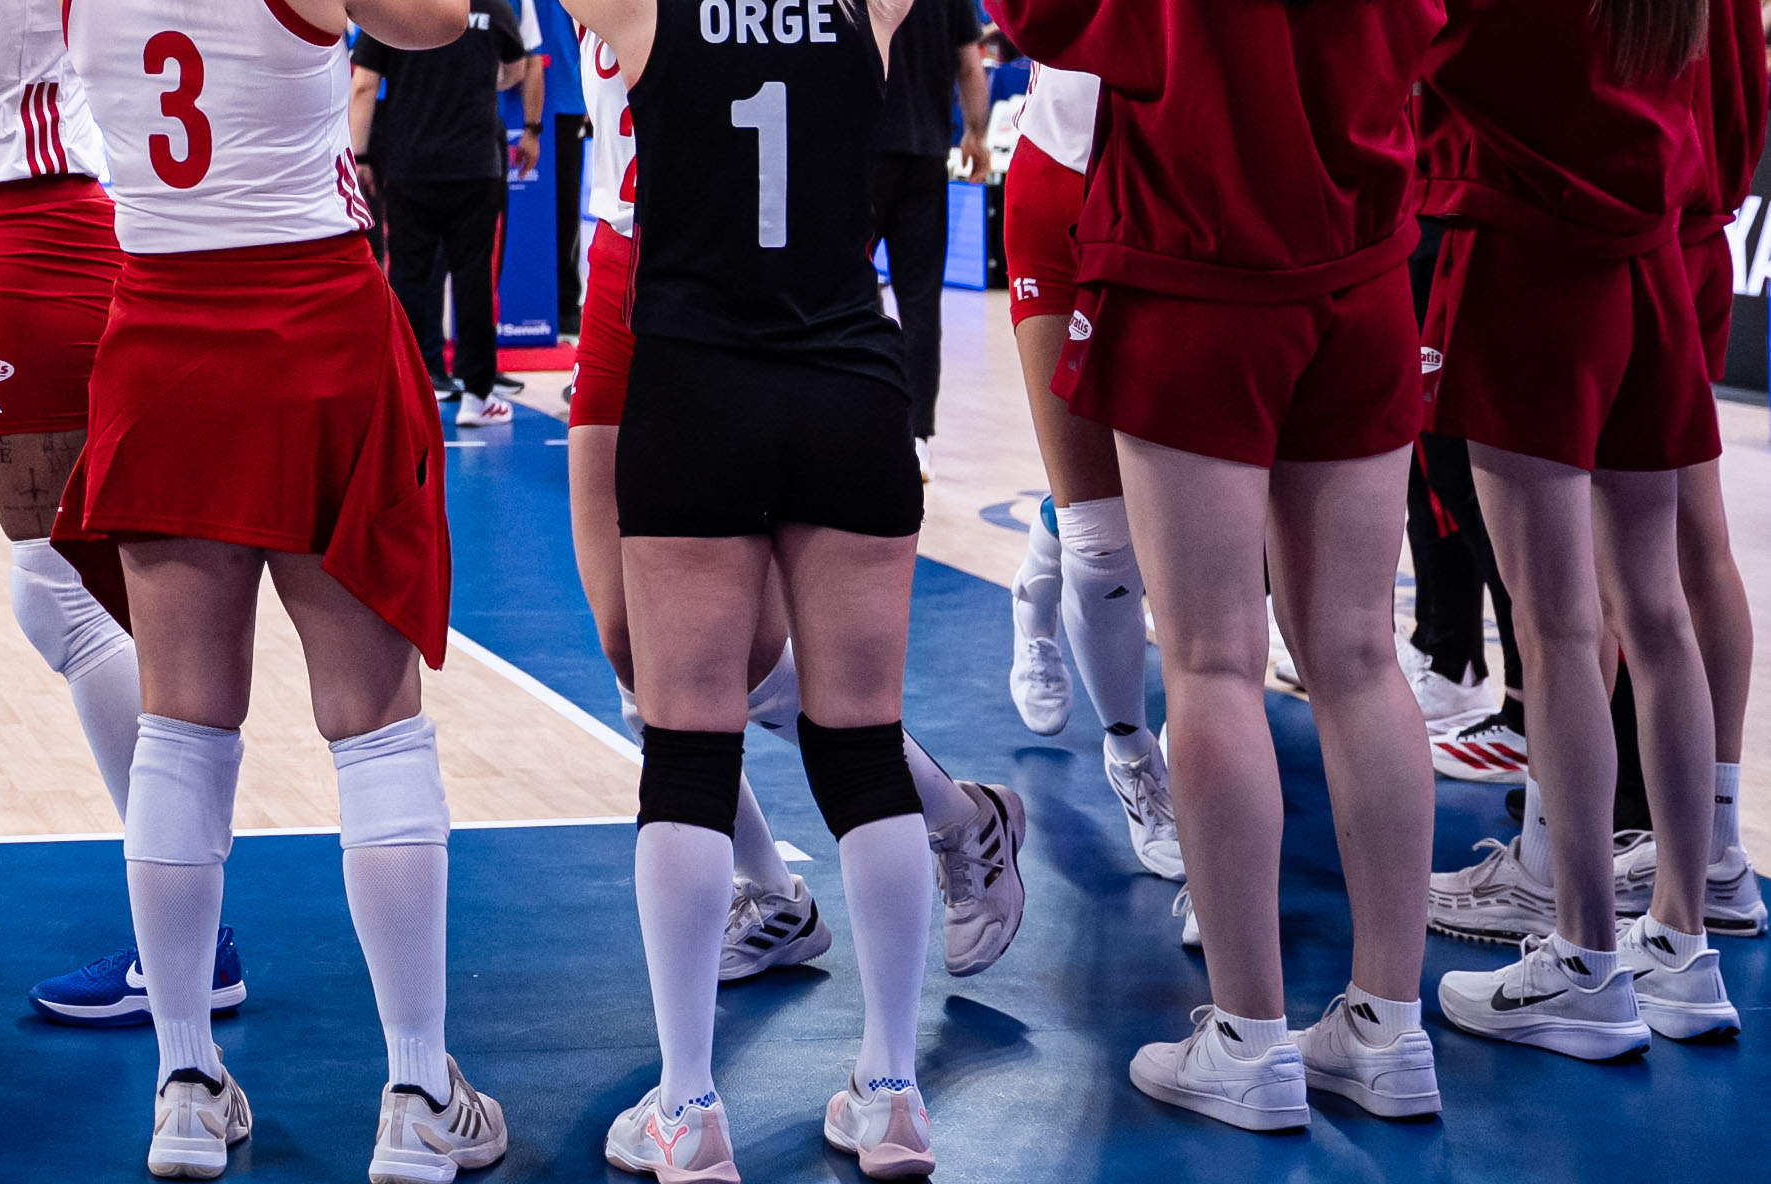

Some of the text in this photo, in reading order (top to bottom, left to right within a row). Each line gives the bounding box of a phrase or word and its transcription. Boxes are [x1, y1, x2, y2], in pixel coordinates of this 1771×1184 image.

[468, 12, 490, 30] YE
[143, 30, 213, 190] 3
[731, 81, 787, 248] 1
[1013, 277, 1040, 301] 15
